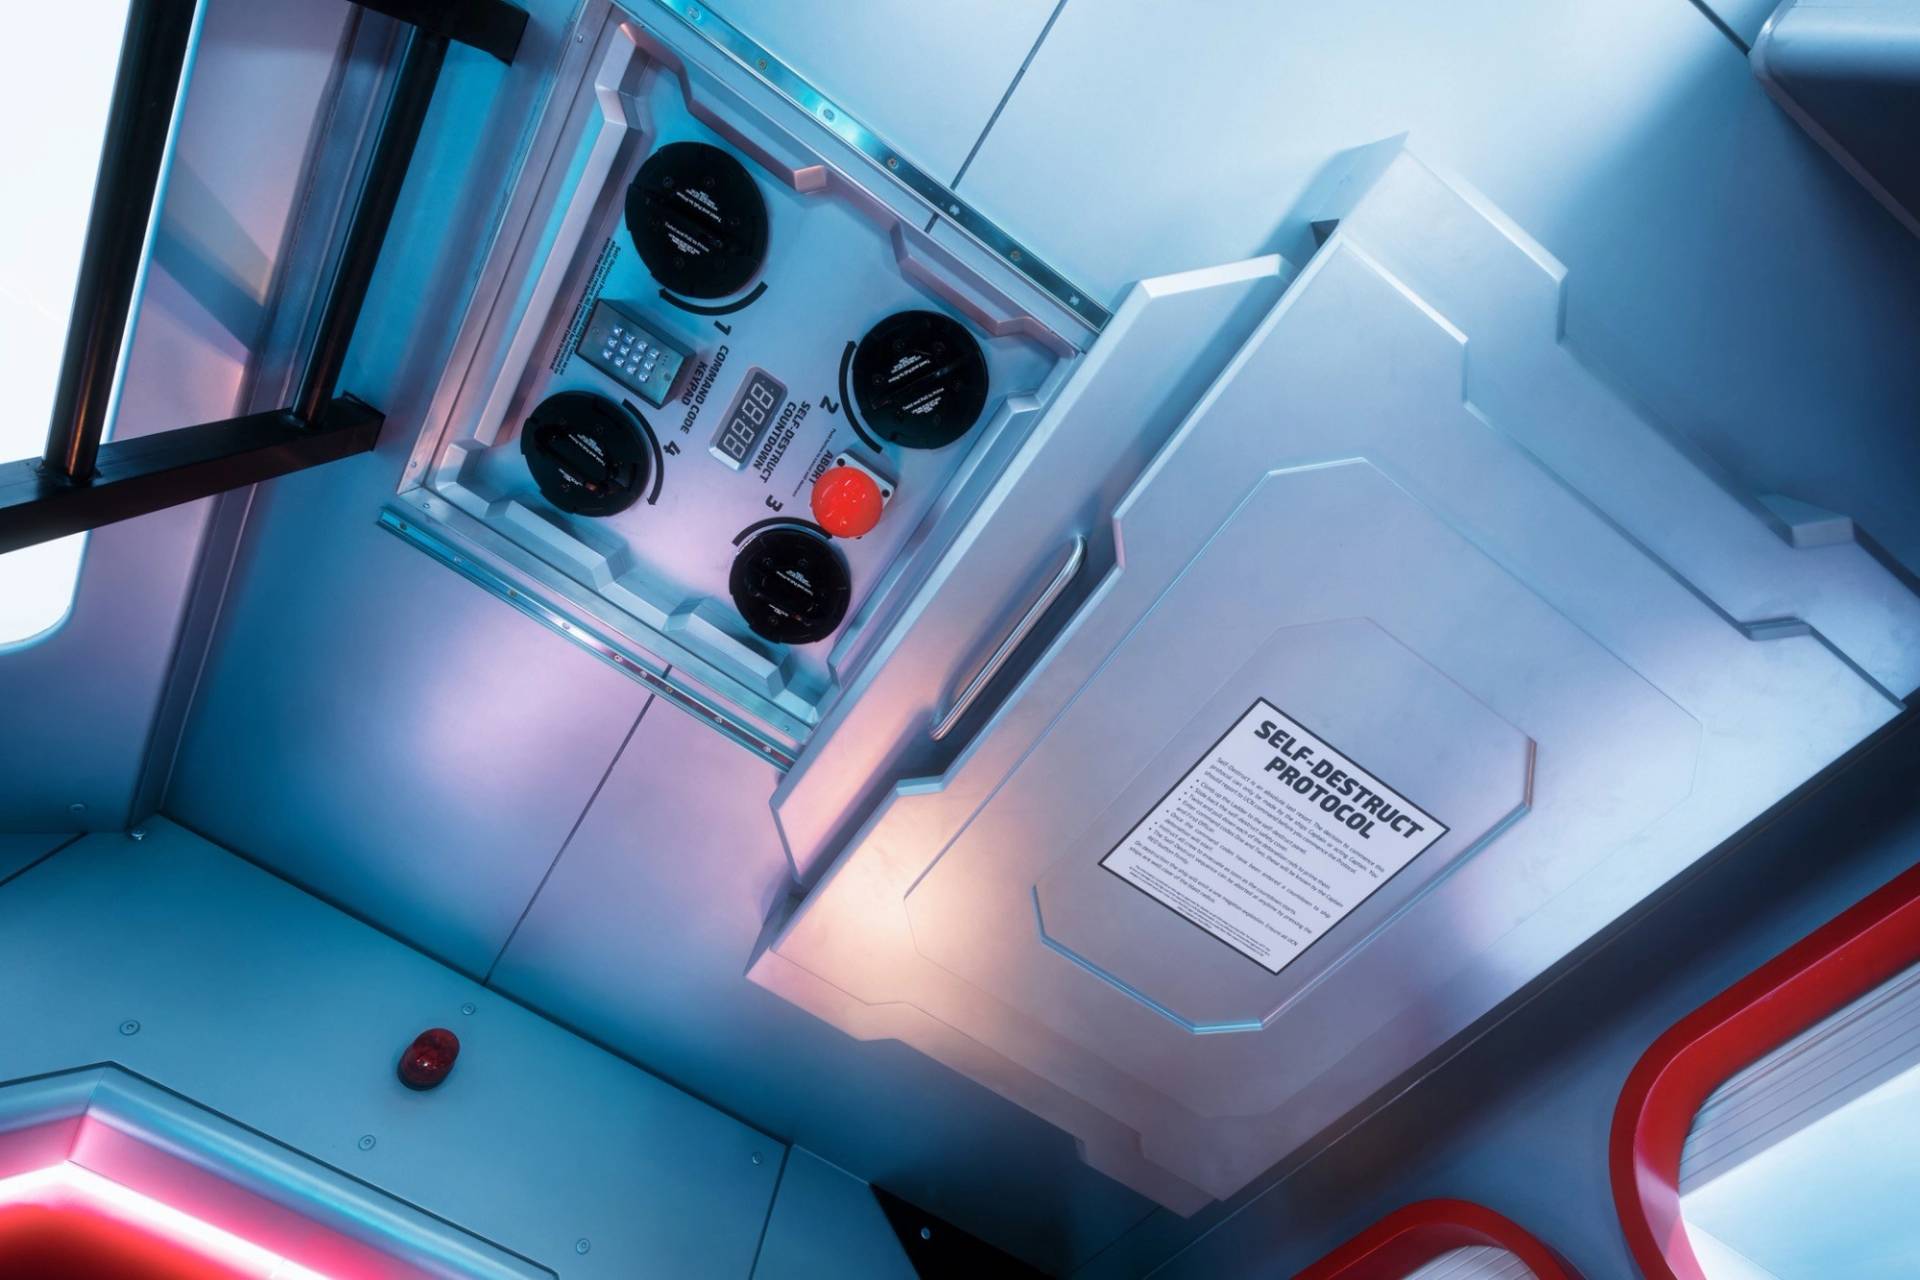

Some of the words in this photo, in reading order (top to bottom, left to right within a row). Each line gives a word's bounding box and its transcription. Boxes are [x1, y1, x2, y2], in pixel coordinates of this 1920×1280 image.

[713, 320, 732, 336] 1
[681, 361, 708, 405] KEYPAD
[694, 345, 729, 404] COMMAND
[680, 404, 700, 434] CODE
[819, 395, 839, 415] 2
[663, 440, 680, 456] 4
[753, 402, 797, 470] COUNTDOWN
[759, 401, 811, 483] SELF-DESTRUCT
[808, 449, 834, 485] ABORT
[765, 494, 784, 512] 3
[1254, 720, 1424, 838] SELF-DESTRUCT
[1264, 756, 1375, 839] PROTOCOL
